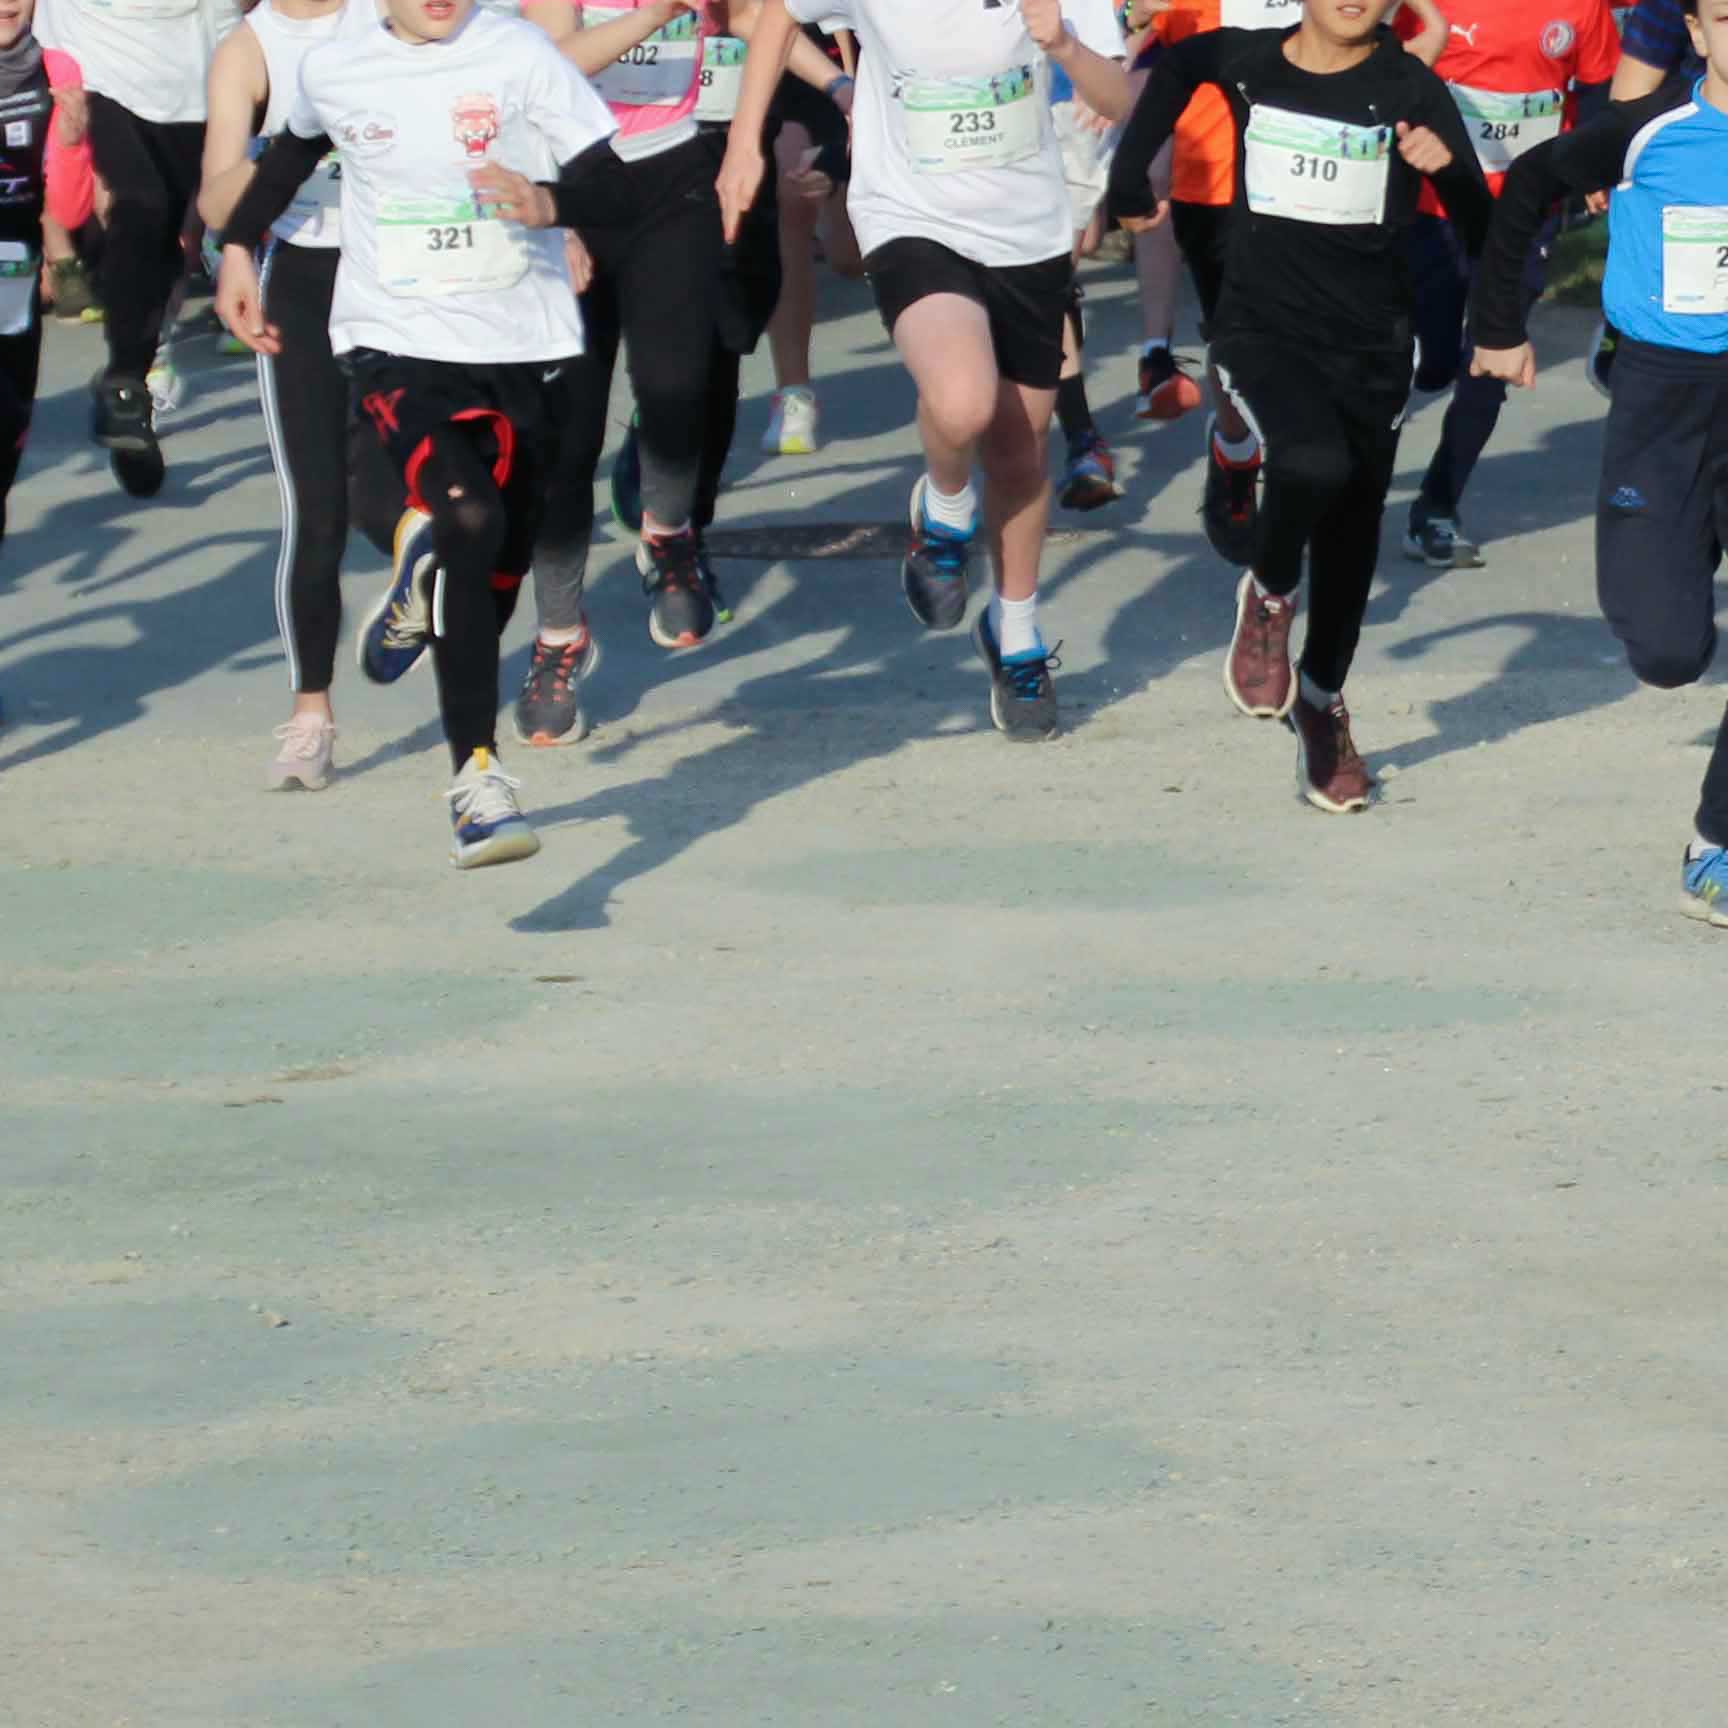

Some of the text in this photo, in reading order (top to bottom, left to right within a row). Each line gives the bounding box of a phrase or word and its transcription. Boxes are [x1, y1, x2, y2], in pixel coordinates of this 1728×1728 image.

[949, 112, 996, 135] 233
[1479, 122, 1521, 141] 284
[1290, 154, 1339, 183] 310
[426, 225, 474, 251] 321
